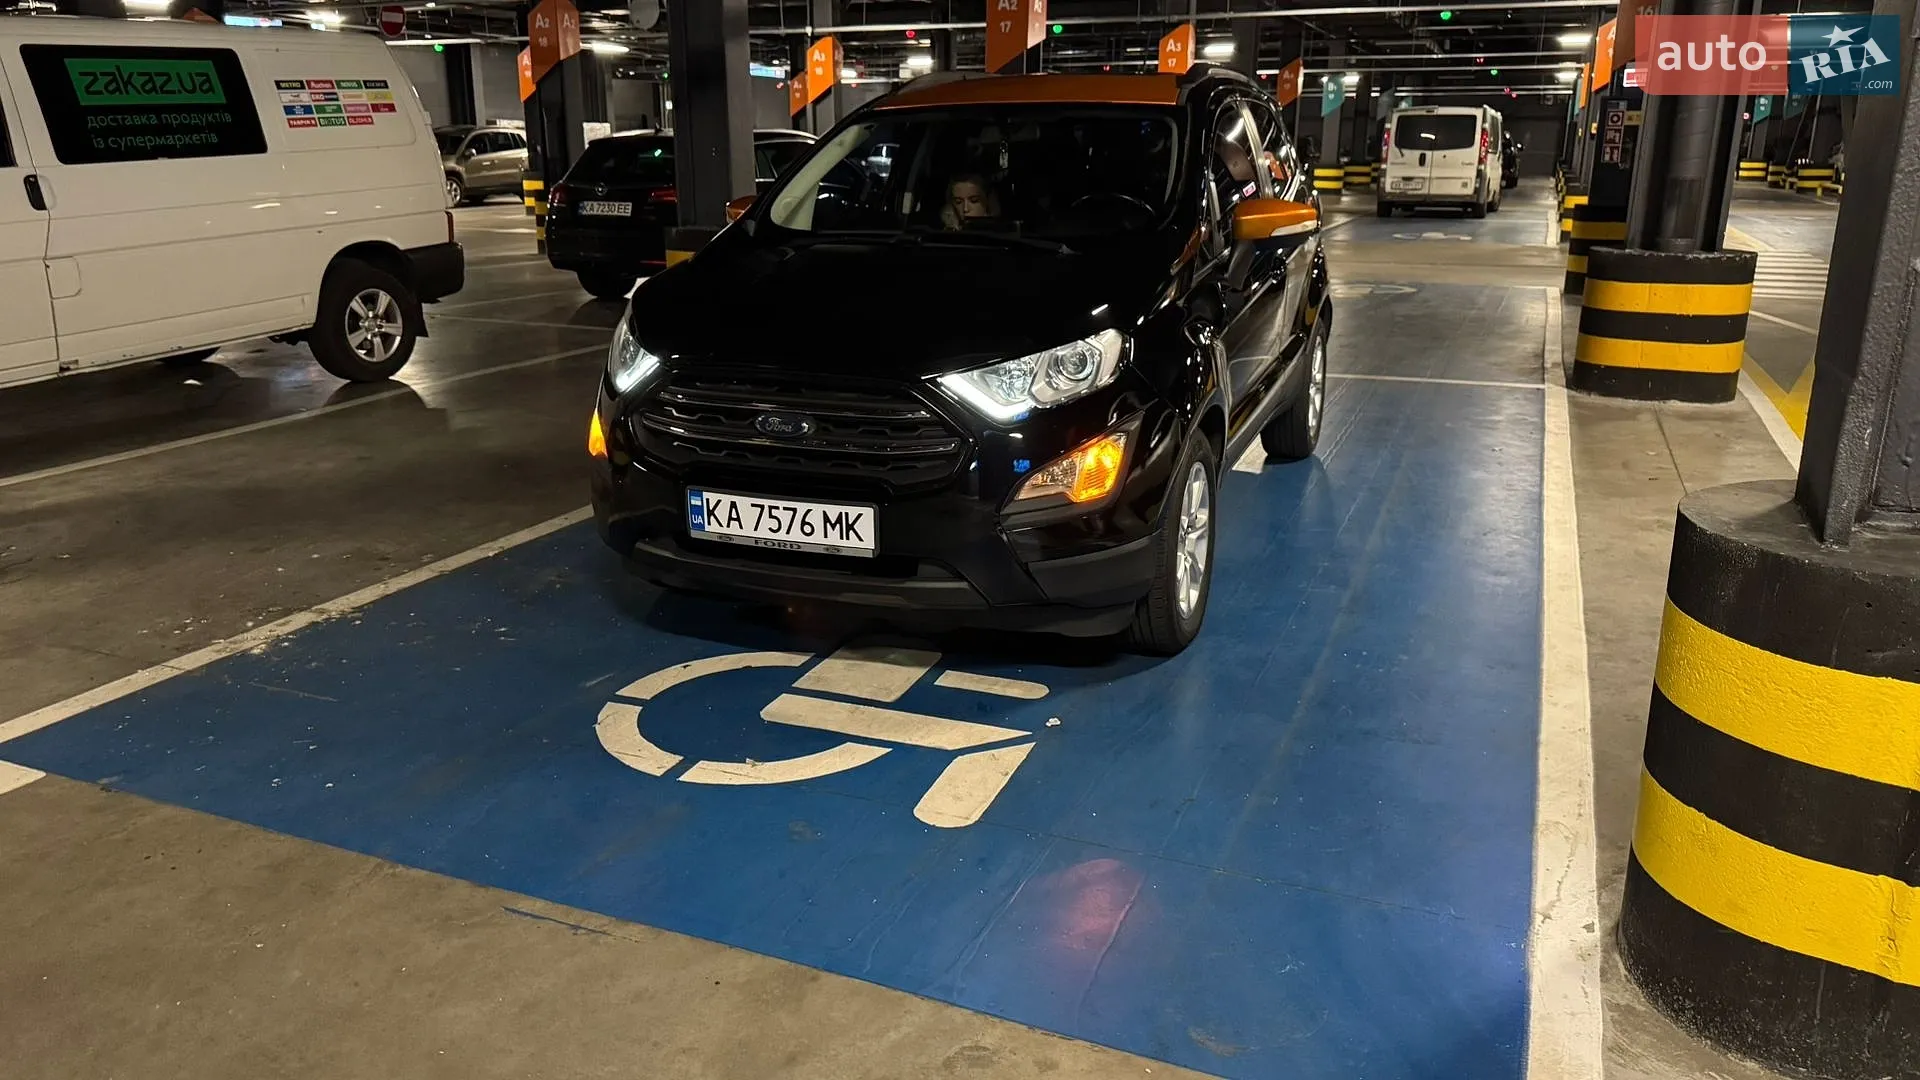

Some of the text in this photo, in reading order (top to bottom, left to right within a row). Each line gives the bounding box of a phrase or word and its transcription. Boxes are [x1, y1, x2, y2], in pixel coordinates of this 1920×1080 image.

[535, 13, 550, 28] A2
[1000, 21, 1012, 33] 17
[1166, 38, 1182, 52] A3
[78, 65, 216, 96] zakaz.ua
[87, 110, 232, 129] доставка продуктів
[92, 130, 219, 151] із супермаркетів
[765, 417, 793, 433] Ford
[692, 514, 704, 525] UA
[705, 497, 864, 543] KA 7576 MK
[754, 538, 802, 551] FORD
